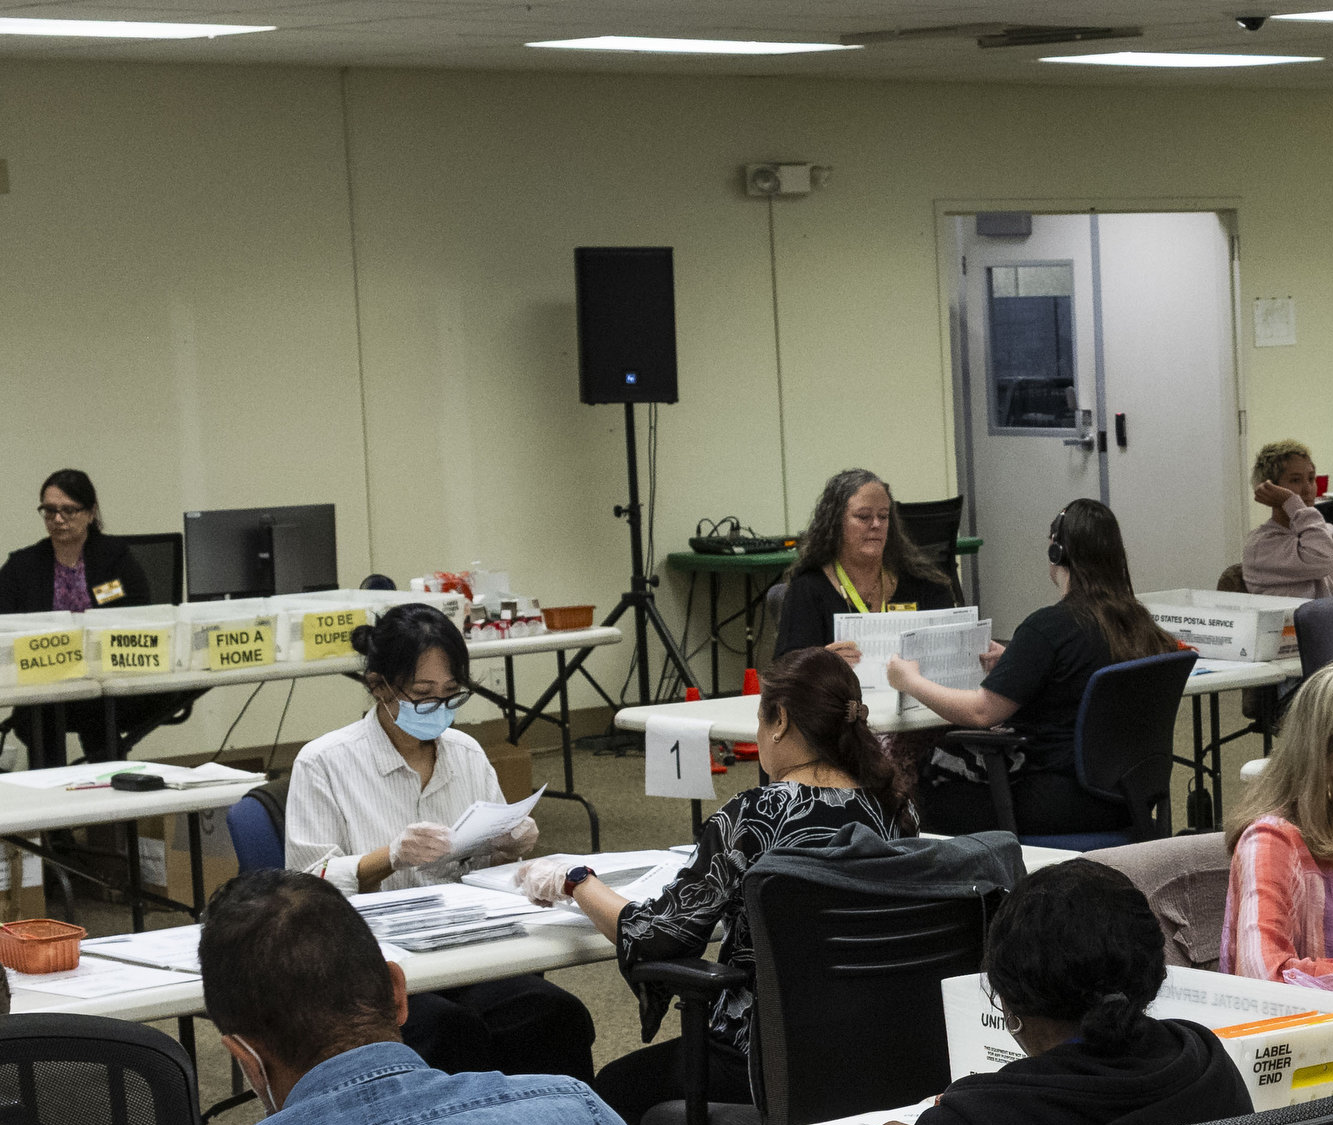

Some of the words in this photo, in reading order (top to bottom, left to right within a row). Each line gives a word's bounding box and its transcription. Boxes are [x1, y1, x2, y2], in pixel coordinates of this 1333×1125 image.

[316, 615, 334, 627] TO
[337, 613, 354, 626] BE
[1160, 614, 1183, 624] STATES
[1183, 615, 1207, 626] POSTAL
[1208, 617, 1234, 629] SERVICE
[29, 634, 70, 651] GOOD
[110, 634, 159, 647] PROBLEM
[216, 631, 249, 647] FIND
[253, 630, 264, 644] A
[20, 650, 83, 670] BALLOTS
[110, 652, 160, 667] BALLOTS
[219, 648, 263, 665] HOME
[669, 739, 682, 780] 1
[1255, 1043, 1292, 1060] LABEL
[1253, 1056, 1292, 1074] OTHER
[1258, 1071, 1283, 1087] END
